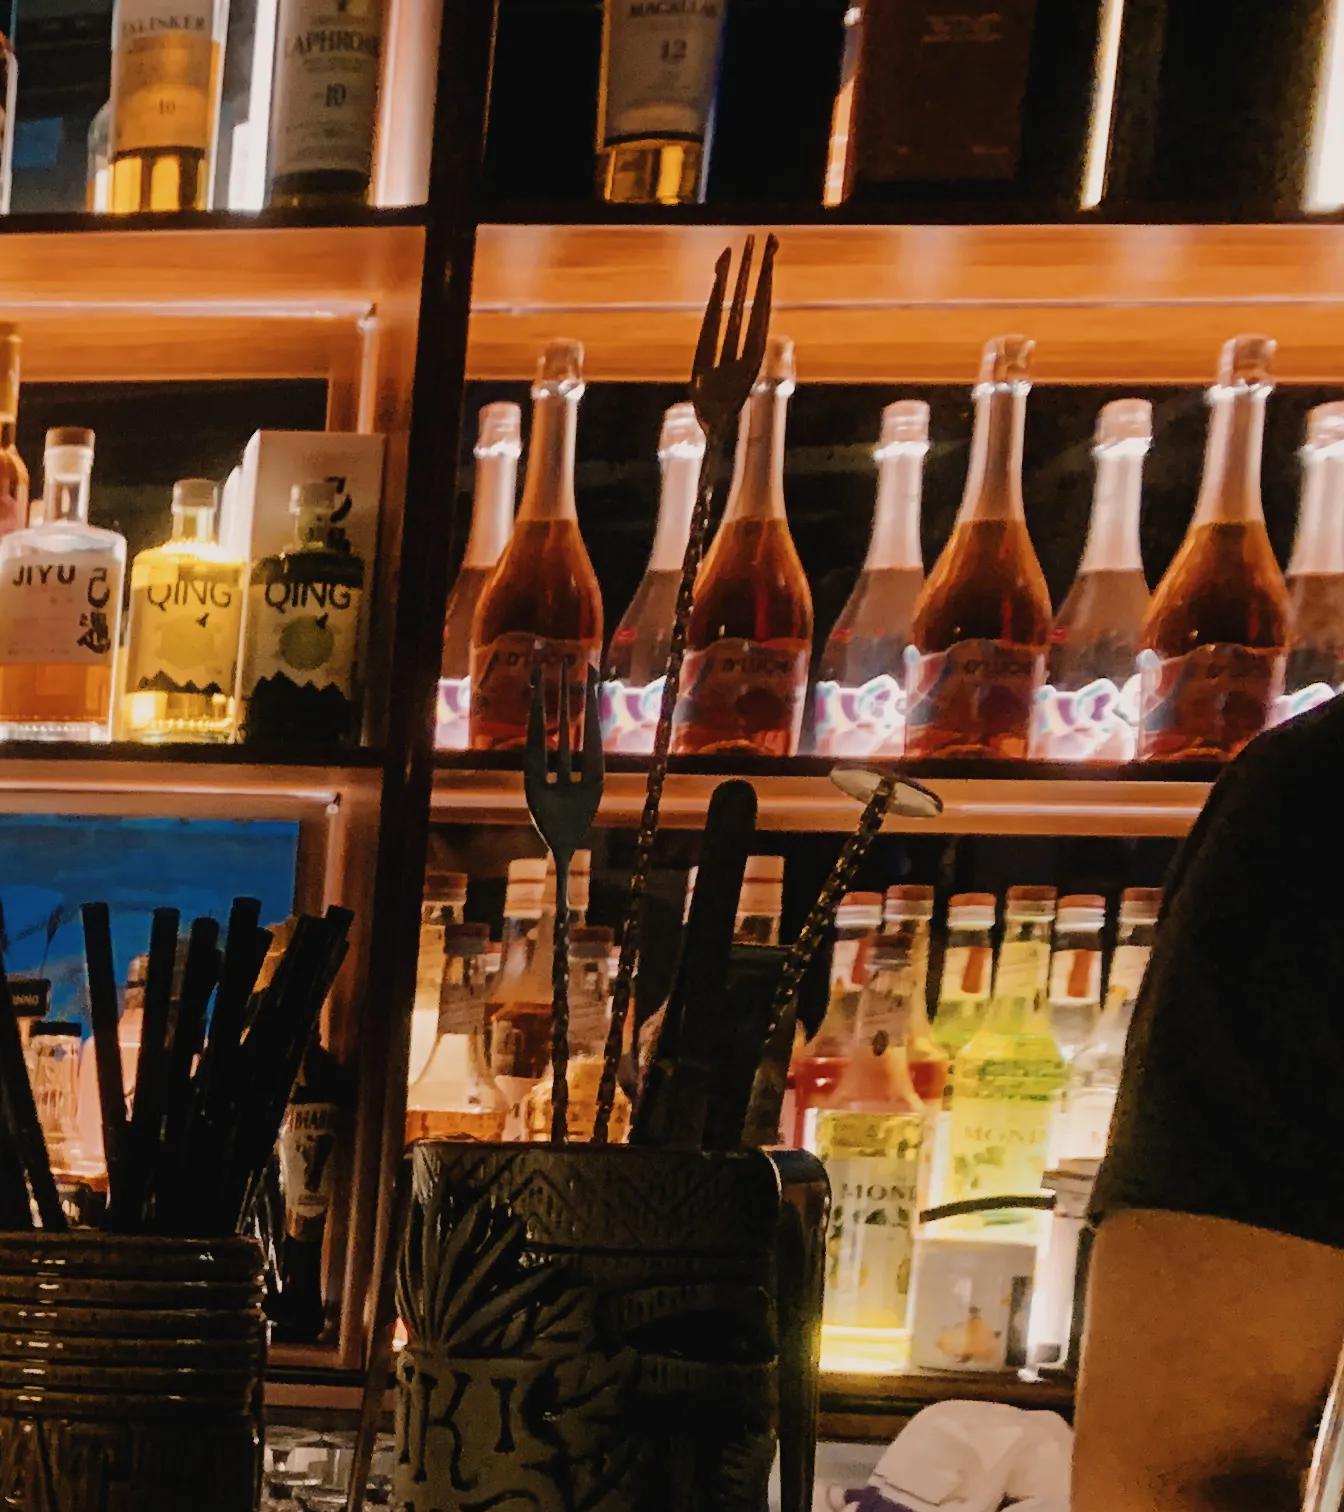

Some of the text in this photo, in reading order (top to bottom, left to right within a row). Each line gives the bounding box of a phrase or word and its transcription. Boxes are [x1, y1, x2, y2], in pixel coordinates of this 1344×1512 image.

[659, 39, 688, 62] 12
[12, 563, 77, 587] JIYU
[146, 581, 232, 612] QING
[264, 581, 352, 614] QING
